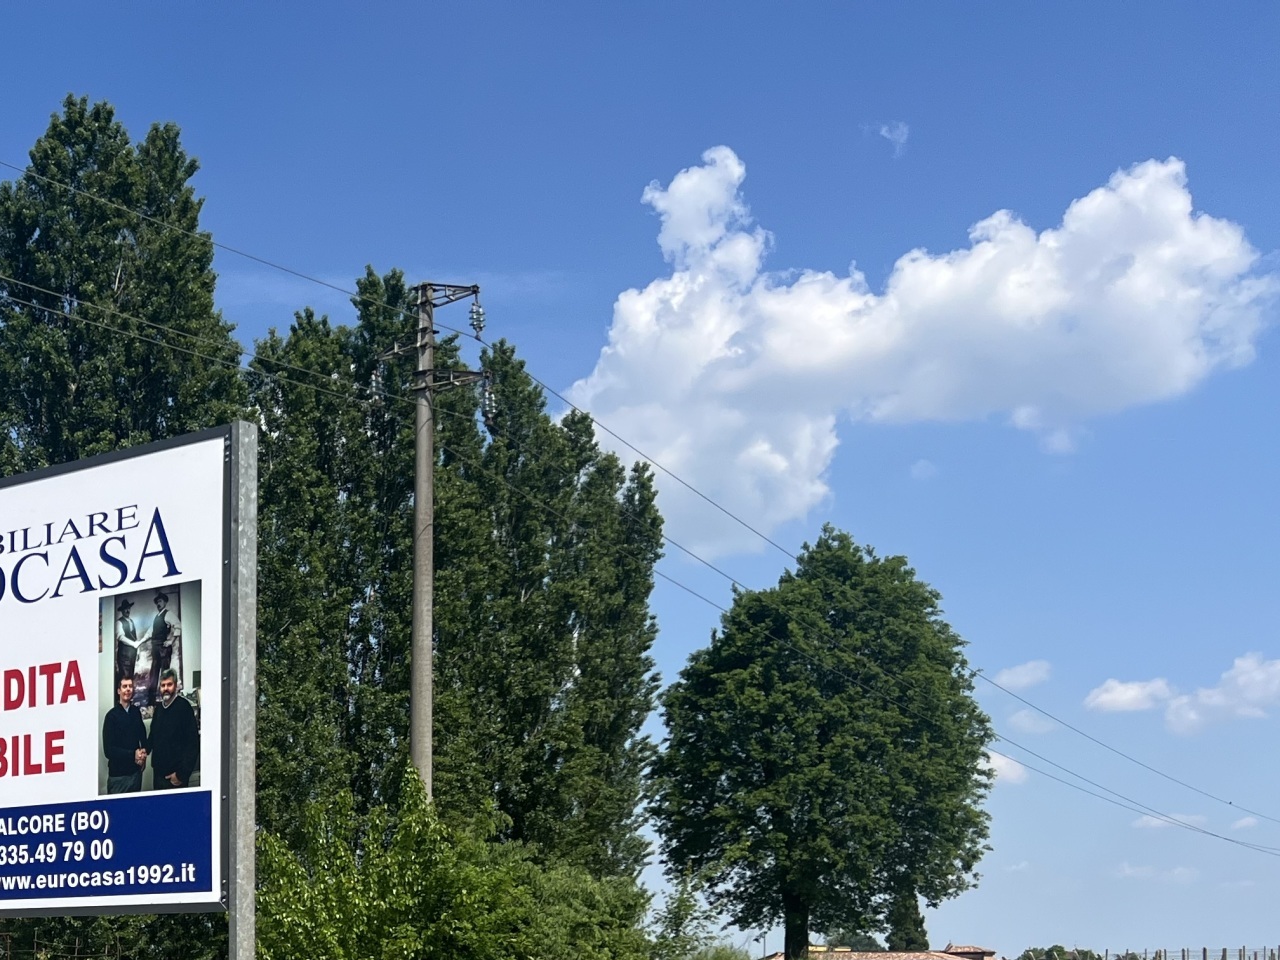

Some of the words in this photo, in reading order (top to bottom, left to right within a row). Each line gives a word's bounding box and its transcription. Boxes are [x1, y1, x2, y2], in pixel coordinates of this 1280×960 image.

[71, 810, 109, 835] (BO)
[63, 841, 84, 861] 79
[91, 839, 113, 860] 00
